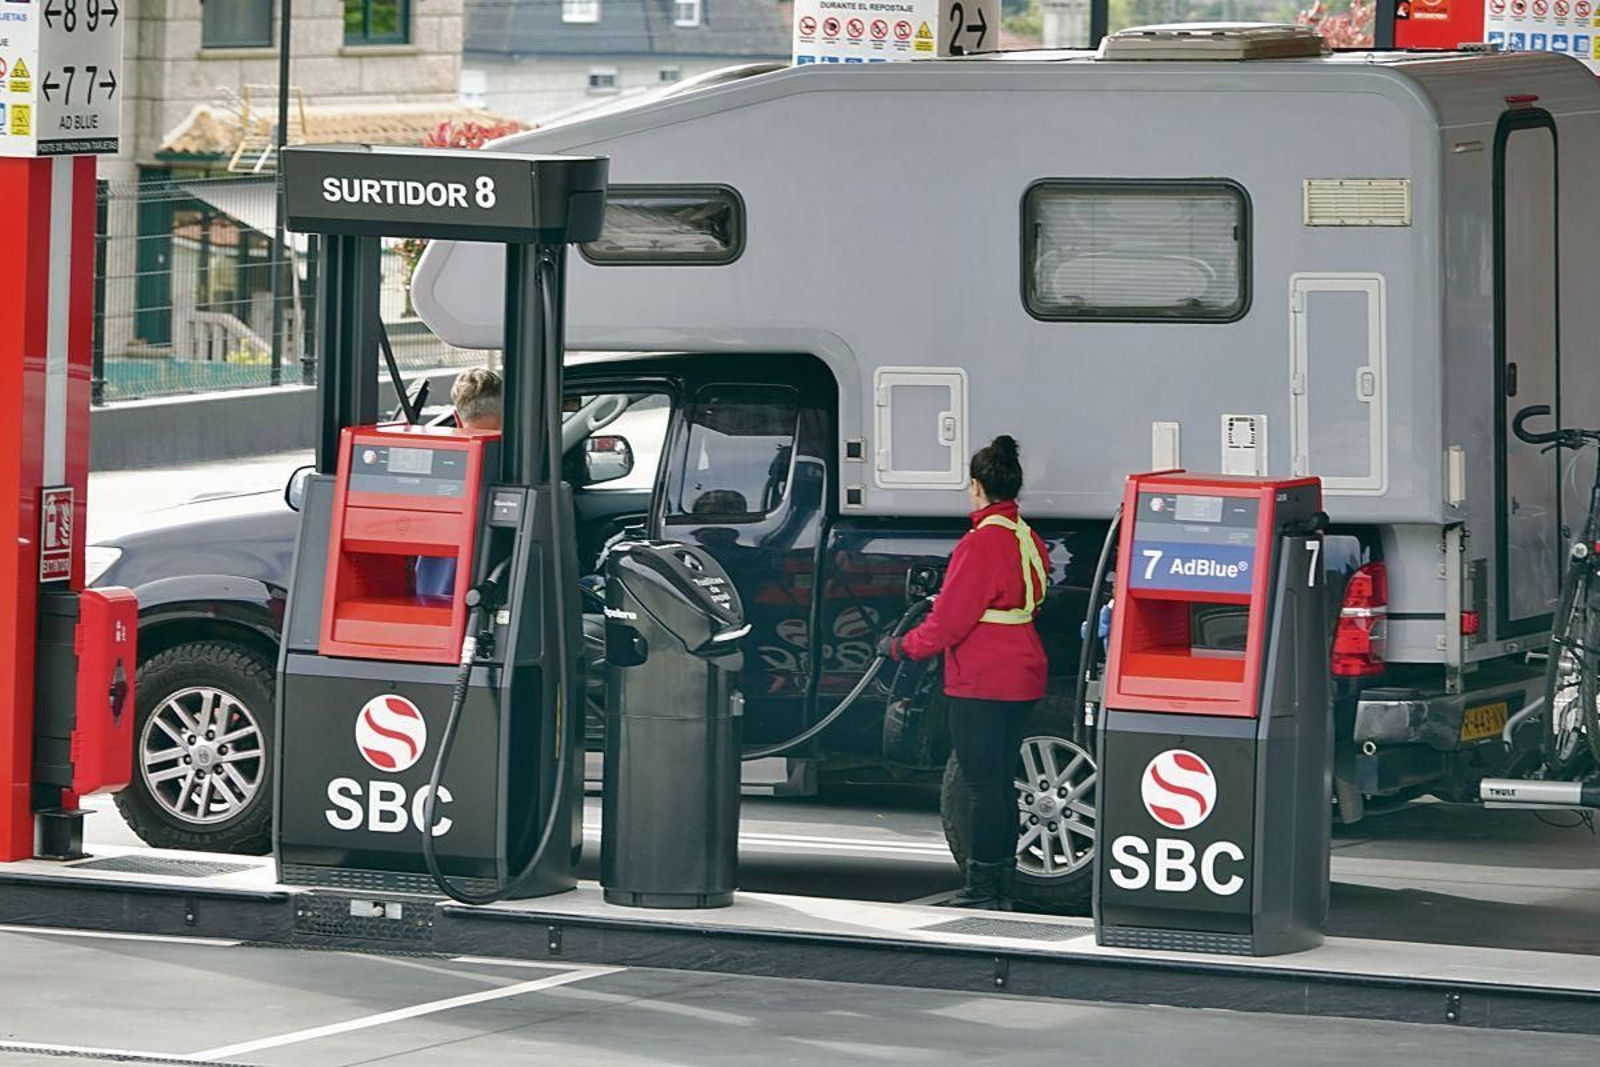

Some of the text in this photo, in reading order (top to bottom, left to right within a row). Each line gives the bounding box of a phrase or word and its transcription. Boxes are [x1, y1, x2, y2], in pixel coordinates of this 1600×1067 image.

[64, 0, 99, 32] 8 9
[820, 1, 857, 10] DURANTE
[869, 3, 914, 13] REPOSTAJE
[949, 2, 964, 56] 2
[63, 66, 98, 105] 7 7
[59, 114, 98, 130] AD BLUE
[322, 175, 496, 209] SURTIDOR 8
[1142, 549, 1163, 580] 7
[1305, 540, 1320, 587] 7
[325, 777, 453, 837] SBC
[1489, 788, 1516, 796] THULE
[1109, 835, 1245, 896] SBC
